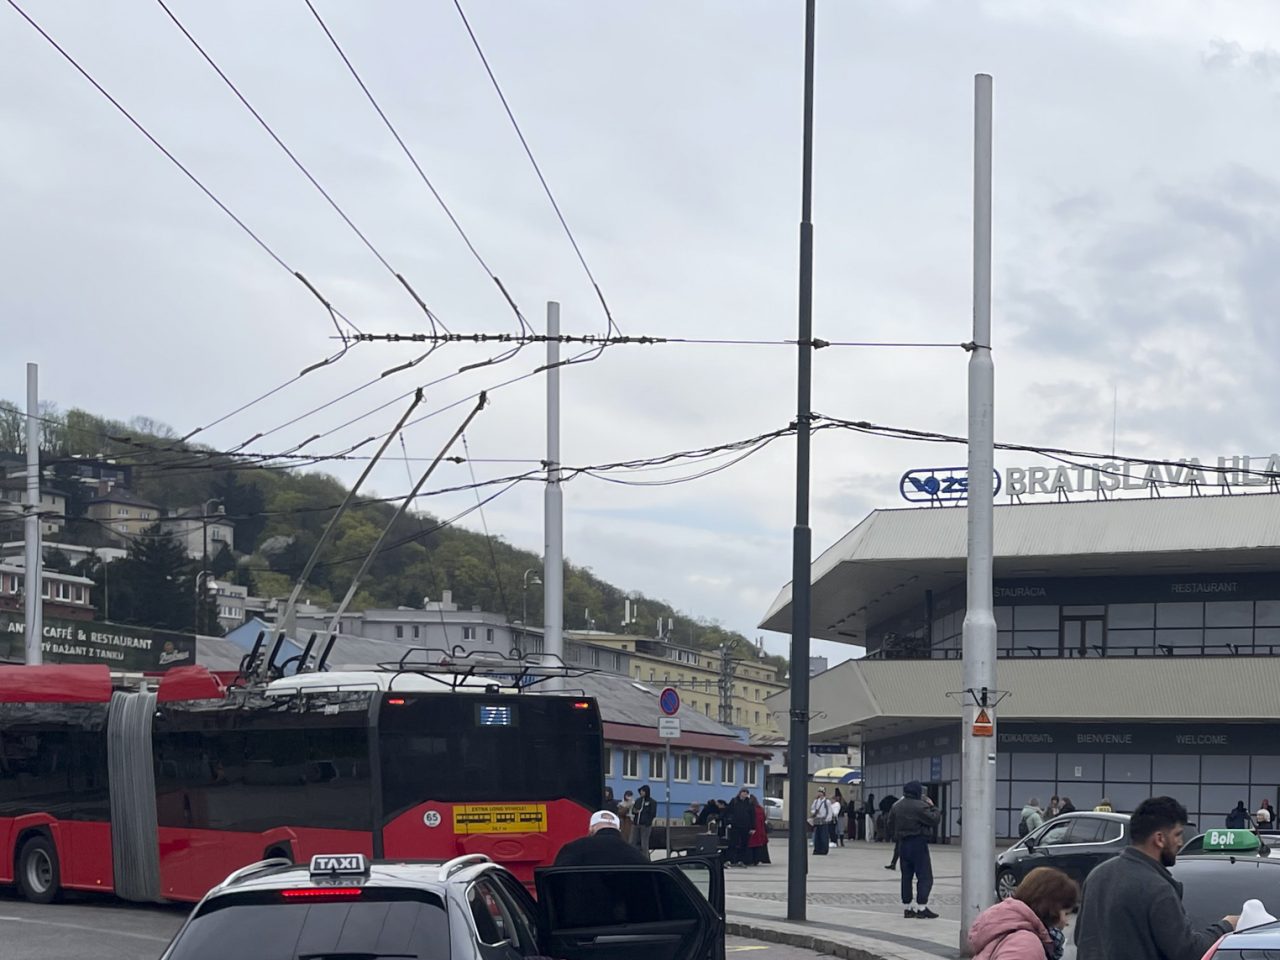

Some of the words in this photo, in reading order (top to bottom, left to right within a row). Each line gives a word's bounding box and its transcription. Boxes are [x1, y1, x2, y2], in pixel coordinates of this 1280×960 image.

[1006, 455, 1207, 496] BRATISLAVA
[993, 586, 1047, 597] ŠTAURÁCIA
[1171, 582, 1238, 593] RESTAURANT
[43, 626, 73, 640] CAFFÉ
[77, 629, 87, 641] &
[90, 632, 153, 650] RESTAURANT
[52, 643, 87, 656] BAŽANT
[88, 649, 95, 657] Z
[95, 650, 124, 661] TANKU
[1077, 734, 1133, 744] BIENVENUE
[1175, 735, 1228, 745] WELCOME
[426, 812, 439, 823] 65
[1210, 831, 1235, 845] Bolt
[317, 858, 357, 869] TAXI
